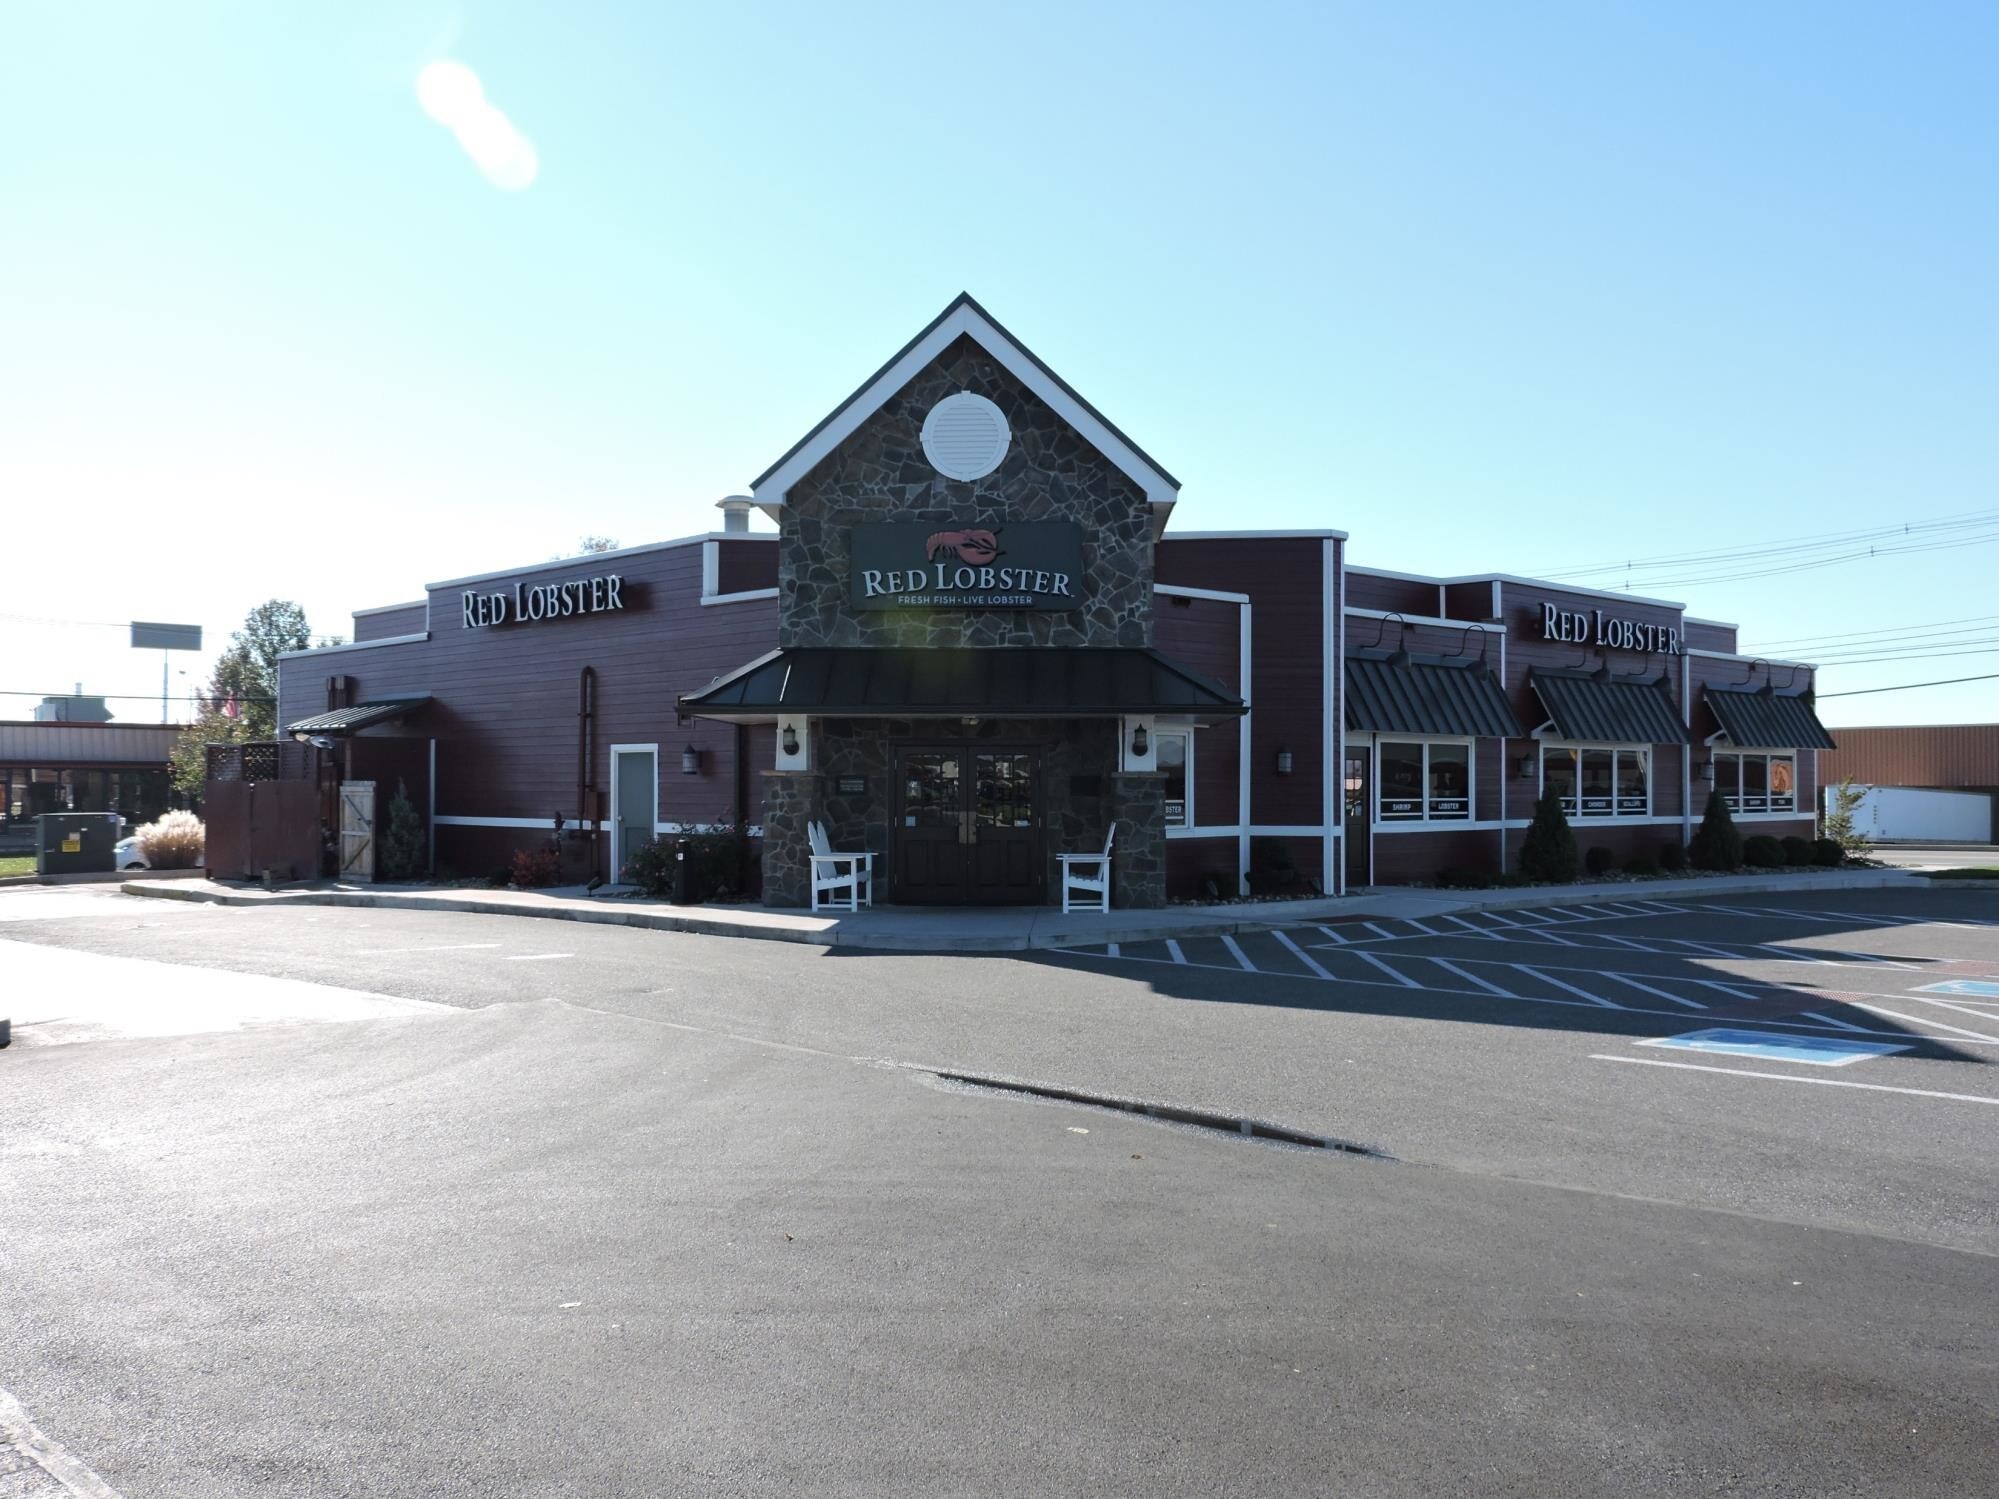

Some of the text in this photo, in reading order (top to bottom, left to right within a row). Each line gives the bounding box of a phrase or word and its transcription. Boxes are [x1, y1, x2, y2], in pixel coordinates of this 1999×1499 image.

[862, 563, 1071, 597] RED LOBSTER
[898, 596, 930, 604] FRESH
[988, 596, 1032, 604] LOBSTER
[461, 575, 623, 629] RED LOBSTER
[1543, 603, 1680, 655] RED LOBSTER
